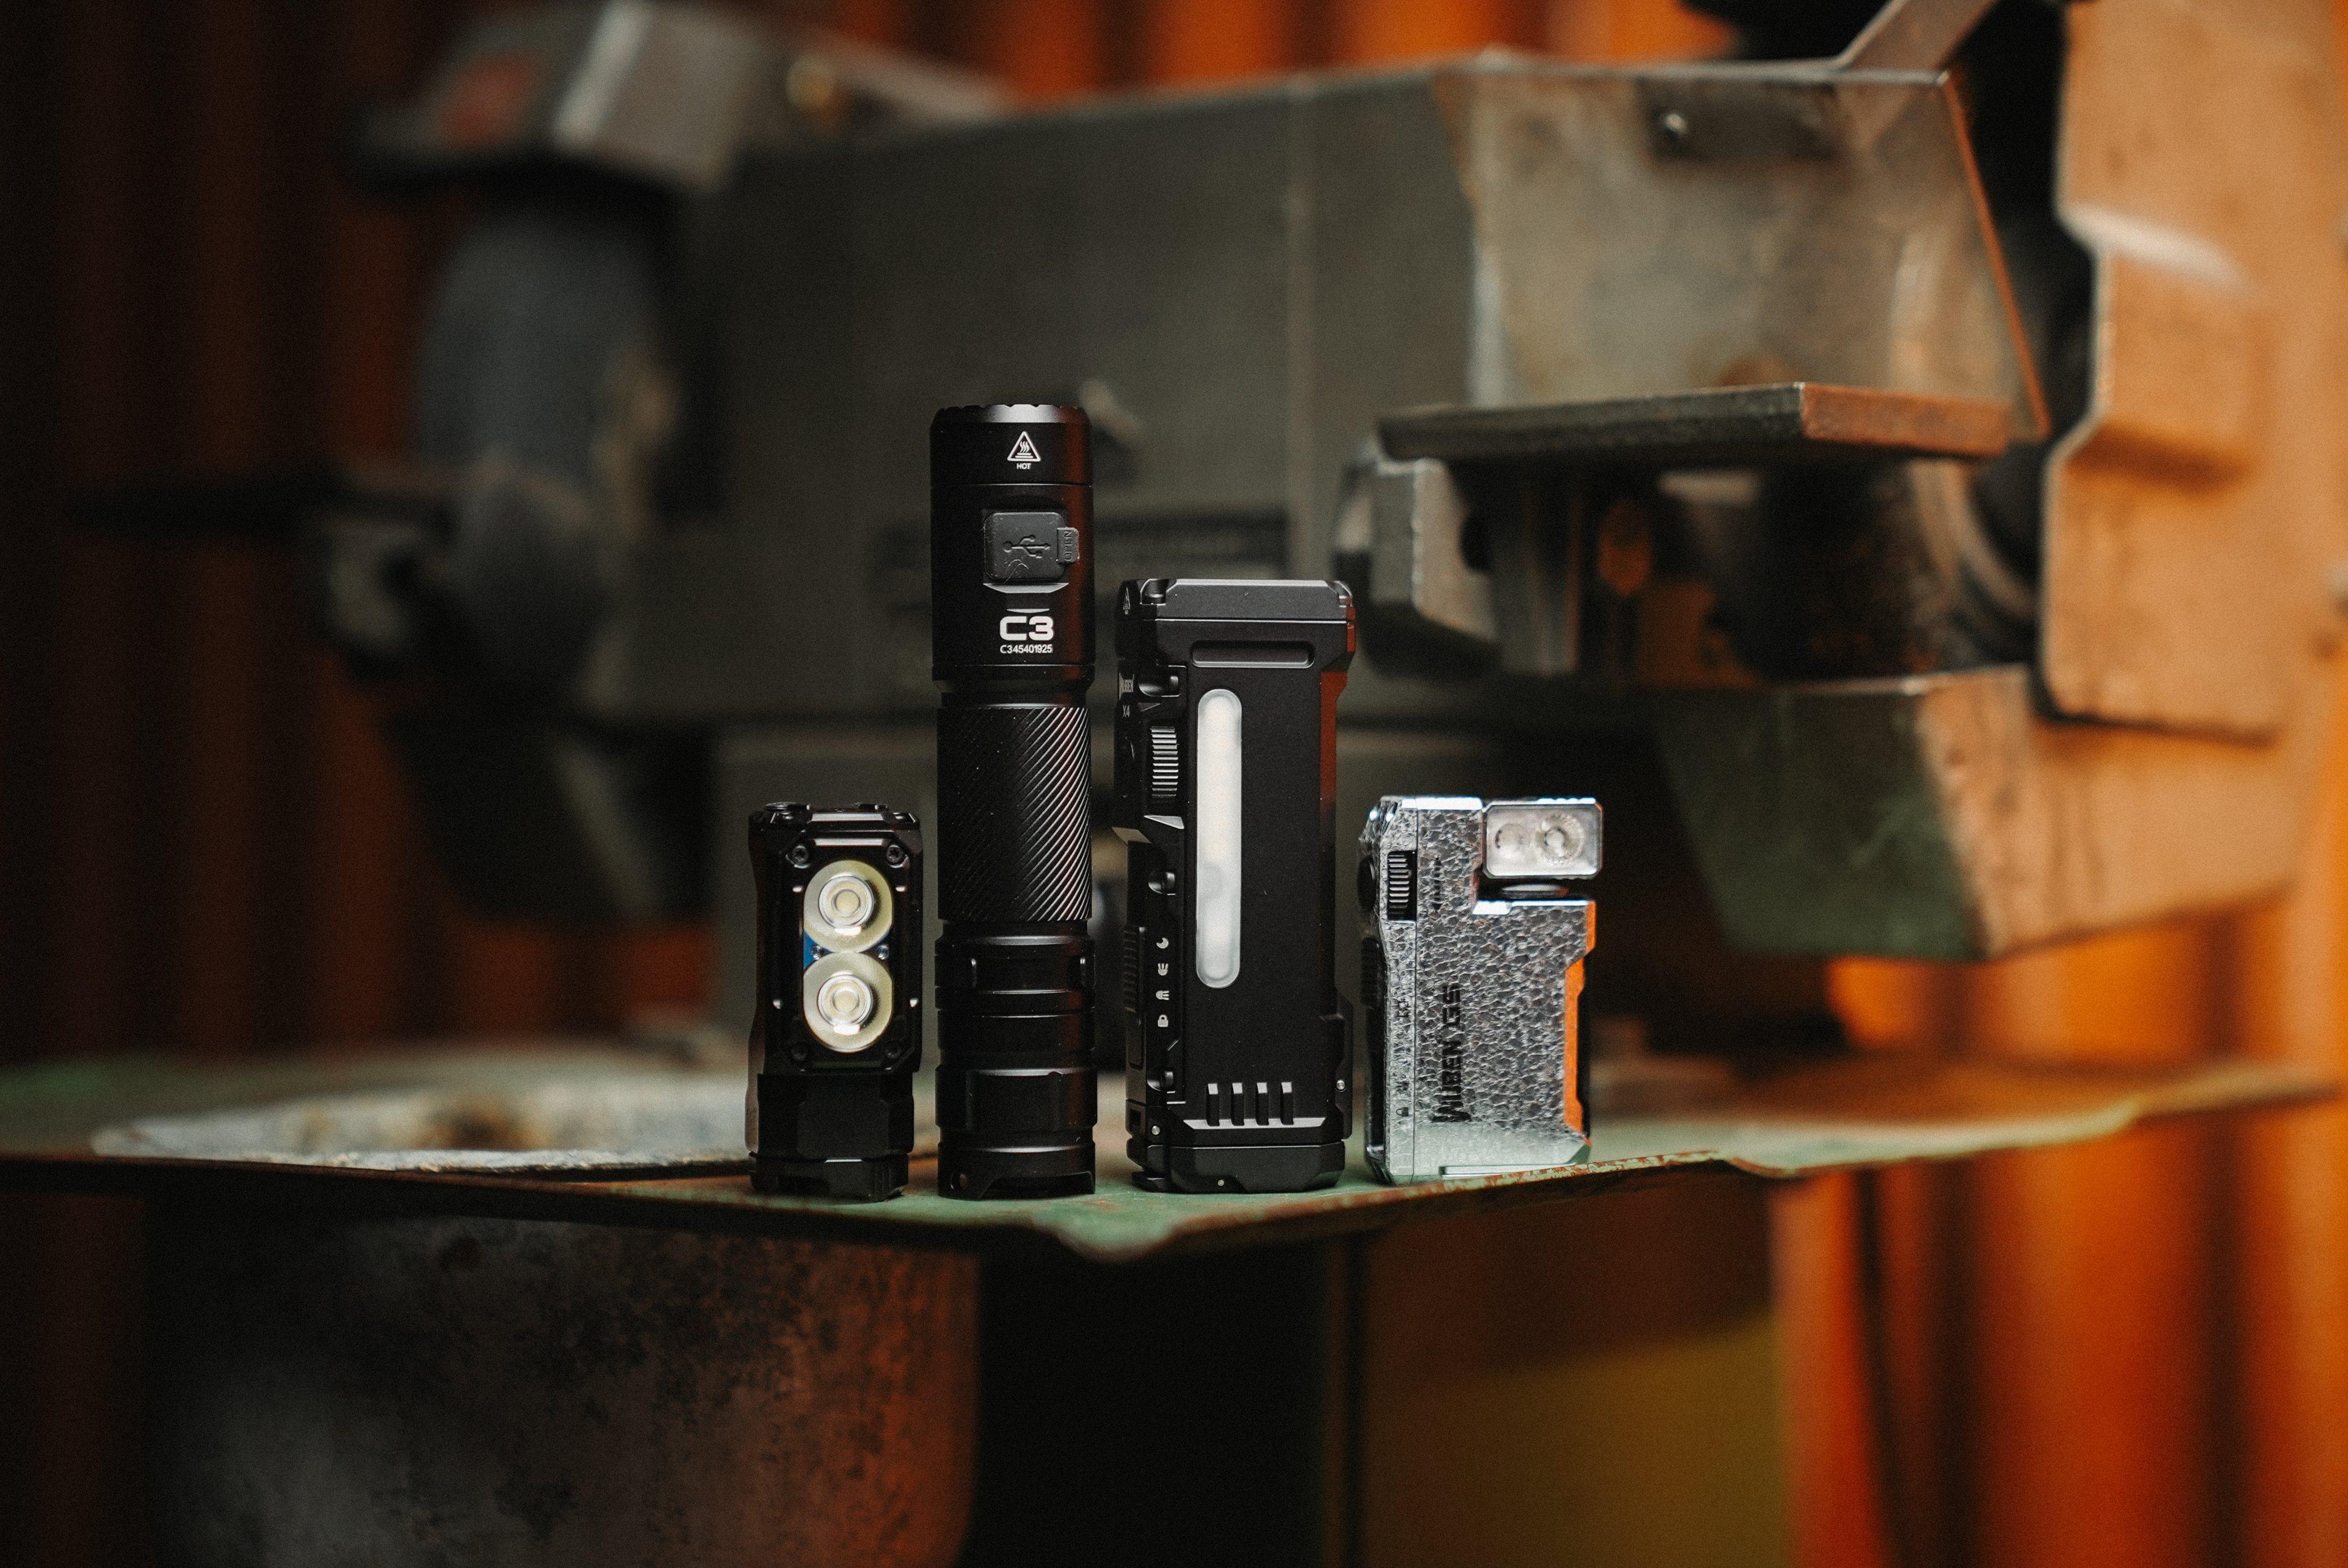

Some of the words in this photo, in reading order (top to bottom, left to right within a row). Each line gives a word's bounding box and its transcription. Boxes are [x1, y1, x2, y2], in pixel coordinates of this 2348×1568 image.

[1063, 530, 1073, 561] OPEN
[1000, 616, 1054, 641] C3
[1000, 644, 1053, 654] C345401925
[1122, 705, 1130, 718] X4
